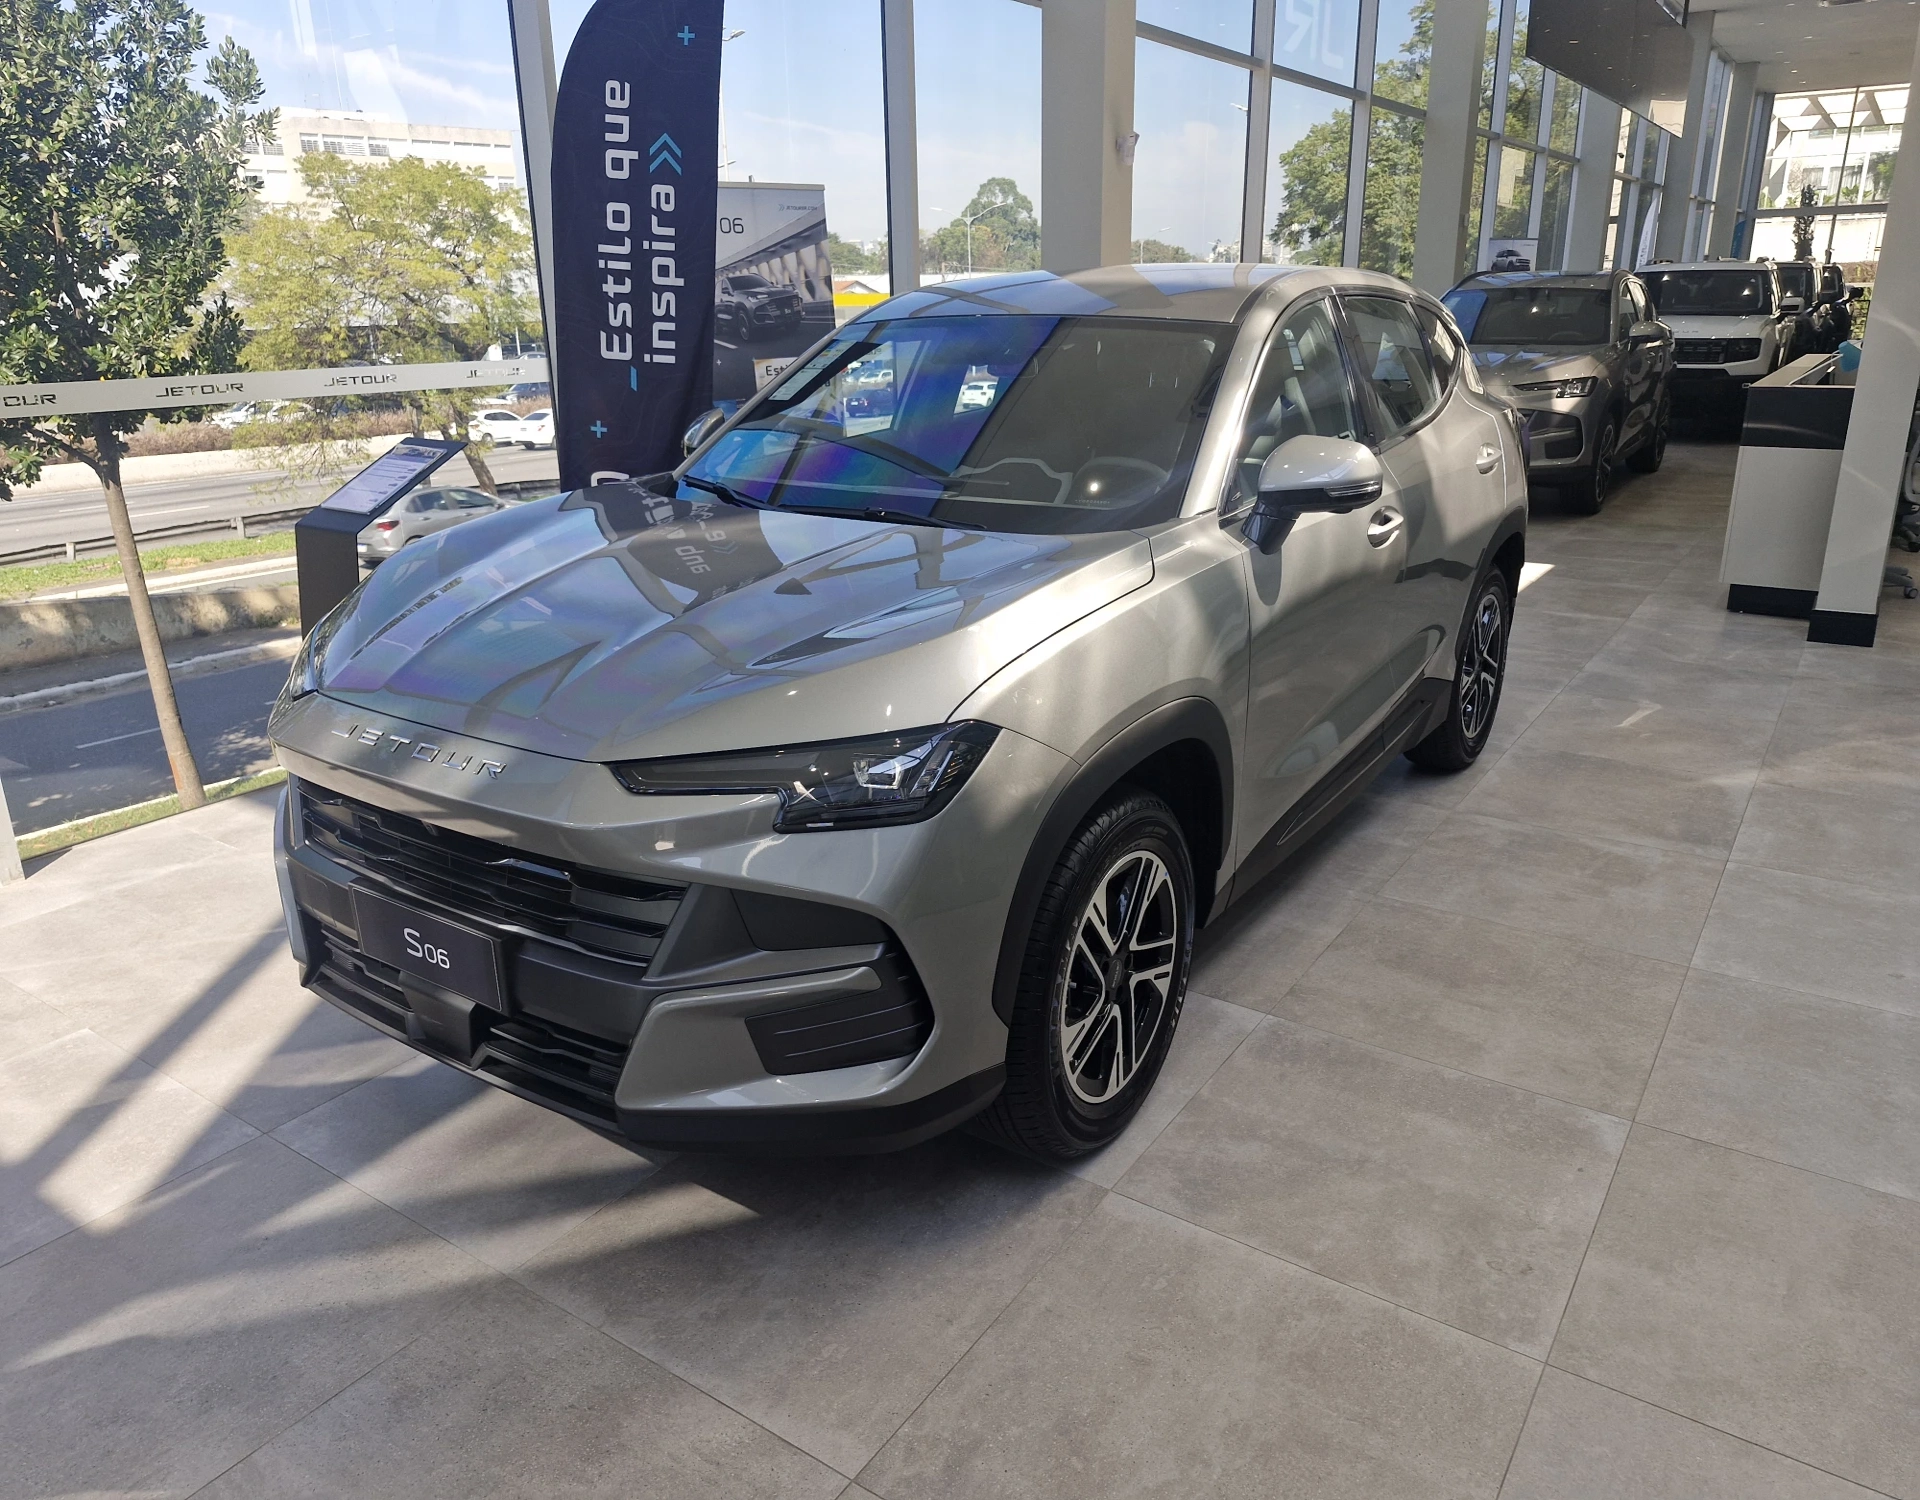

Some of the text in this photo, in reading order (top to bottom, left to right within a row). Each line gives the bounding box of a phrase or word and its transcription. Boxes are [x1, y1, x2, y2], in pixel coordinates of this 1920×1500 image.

[597, 79, 639, 361] Estilo que
[643, 183, 685, 364] inspira
[155, 382, 245, 398] JETOUR
[323, 373, 397, 387] JETOUR
[331, 723, 507, 779] JETOUR
[403, 927, 450, 969] S06
